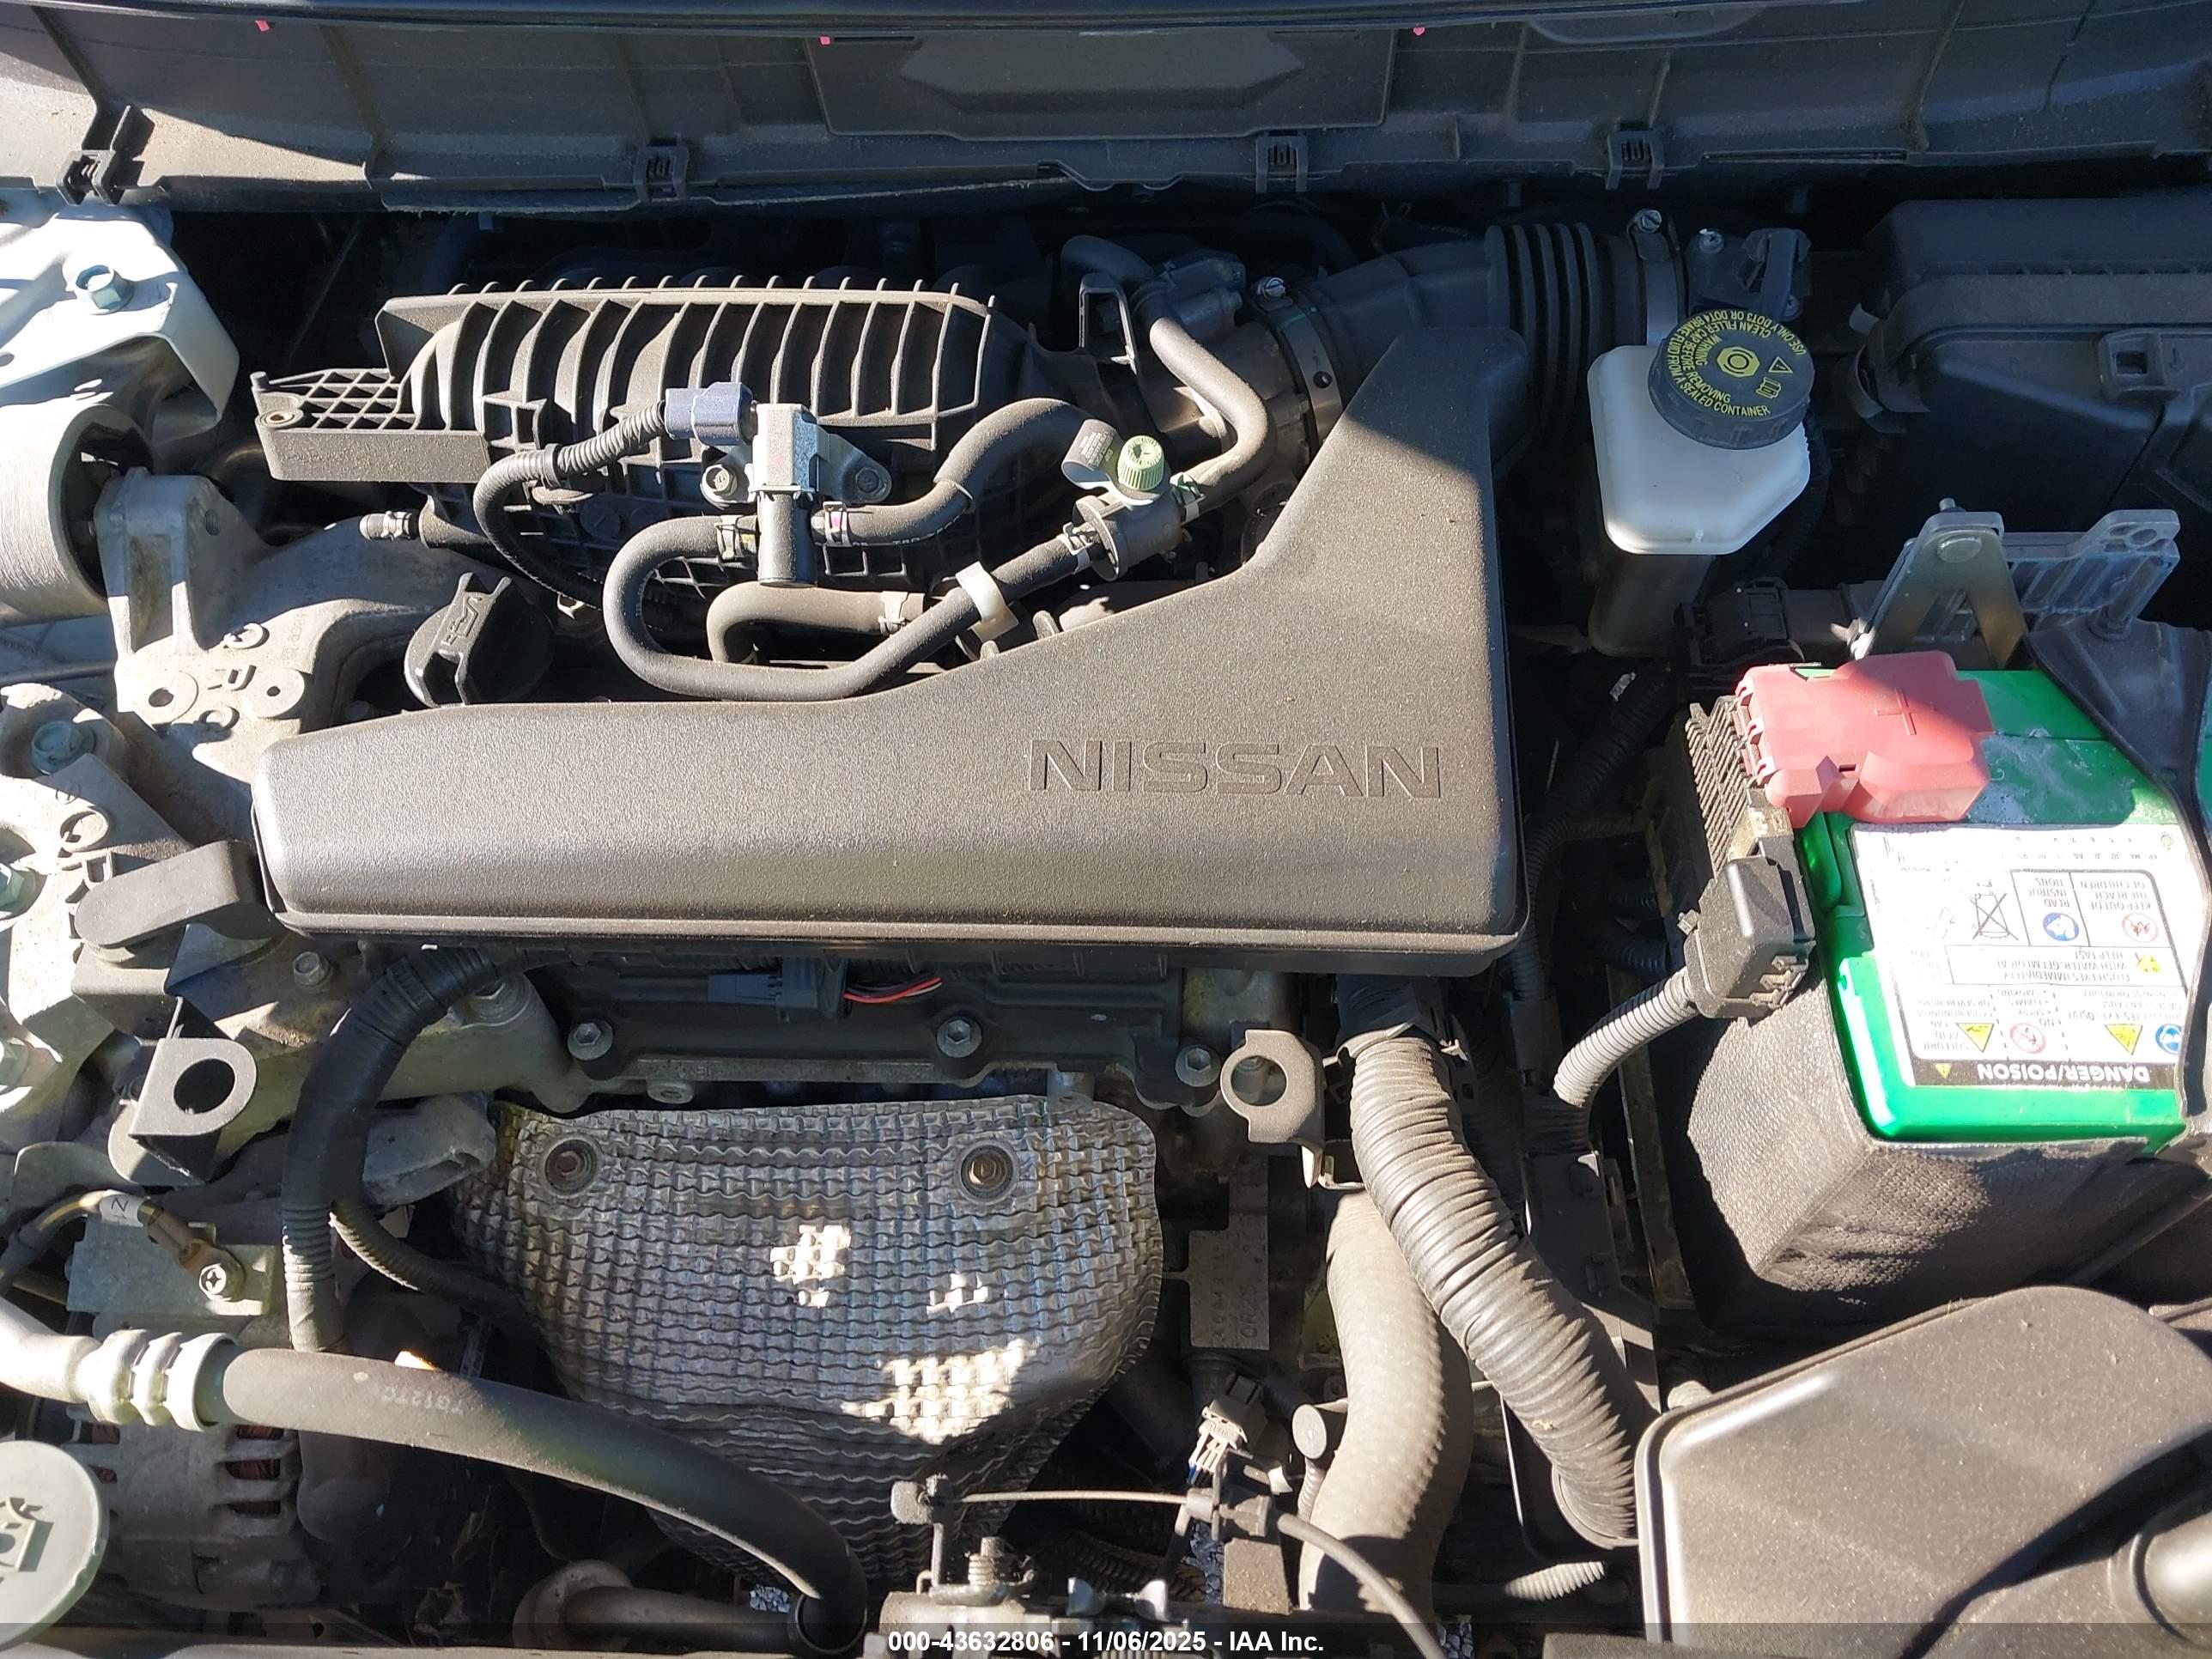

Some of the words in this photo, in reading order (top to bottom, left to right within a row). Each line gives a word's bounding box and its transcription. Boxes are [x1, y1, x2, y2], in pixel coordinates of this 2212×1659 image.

[1705, 311, 1729, 322] DOT4
[1730, 311, 1744, 320] OR
[1747, 313, 1771, 329] DOT3
[1677, 317, 1705, 336] BRAKE
[1705, 321, 1737, 337] FILLER
[1739, 323, 1771, 337] CLEAN
[1770, 323, 1793, 342] ONLY
[1690, 330, 1708, 343] CAP
[1668, 335, 1685, 355] FLUID
[1696, 334, 1722, 366] WARNING
[1789, 340, 1807, 356] USE
[1680, 340, 1697, 371] BEFORE
[1668, 356, 1680, 377] FROM
[1675, 376, 1686, 386] A
[1687, 371, 1731, 403] REMOVING
[1680, 382, 1713, 407] SEALED
[1714, 403, 1771, 416] CONTAINER
[1030, 739, 1441, 799] NISSAN
[2044, 898, 2069, 907] READ
[2106, 902, 2124, 910] OUT
[1977, 1063, 2150, 1083] DANGER/POISON
